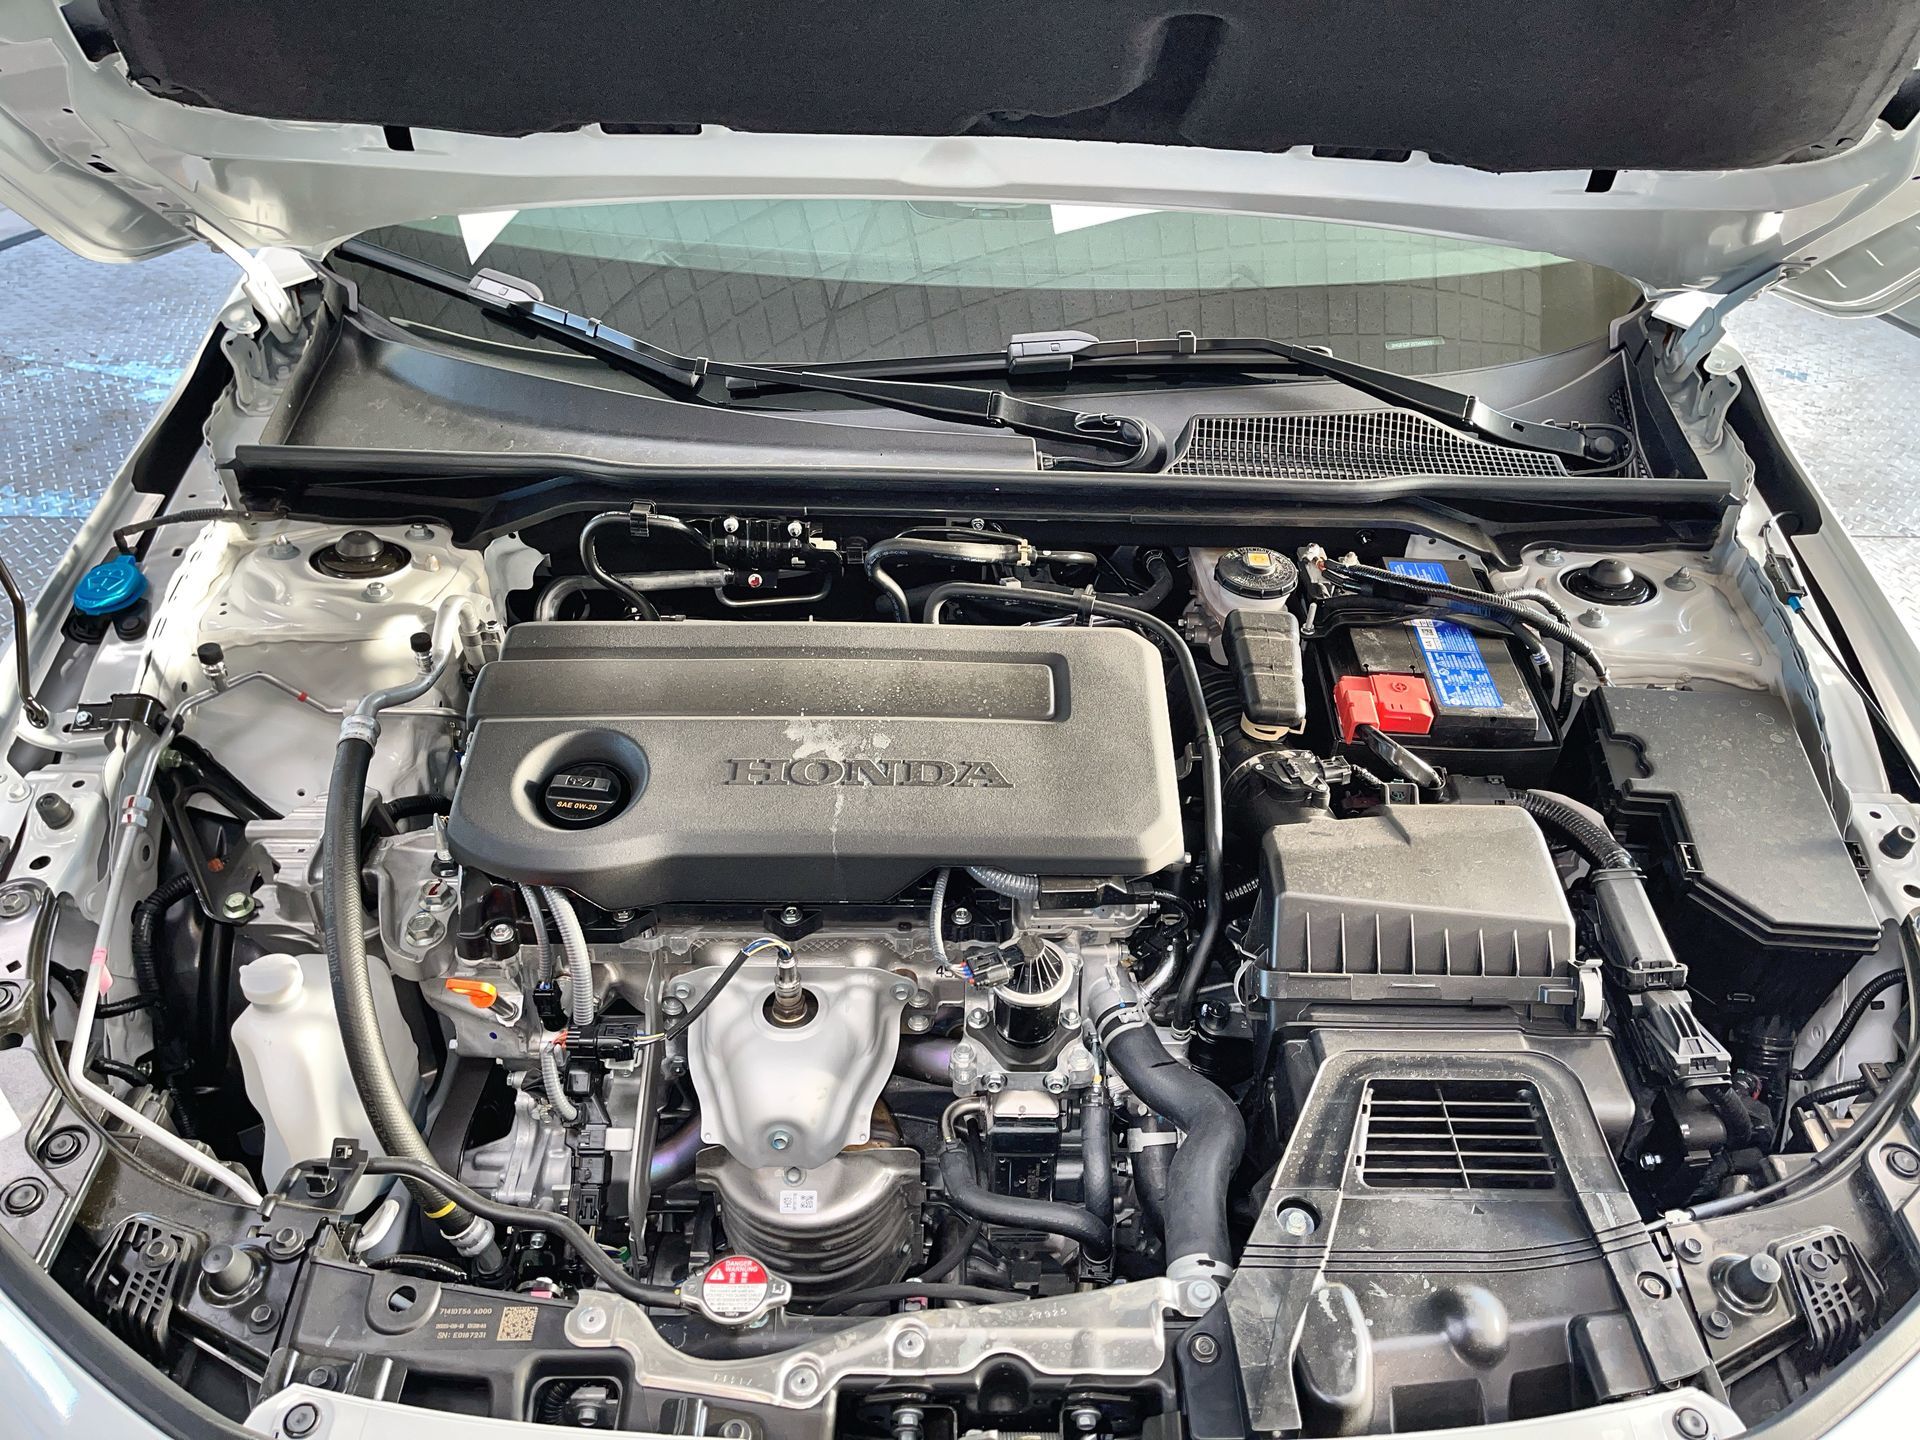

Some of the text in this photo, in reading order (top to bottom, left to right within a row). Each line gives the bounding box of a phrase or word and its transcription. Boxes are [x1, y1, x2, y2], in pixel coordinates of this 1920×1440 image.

[722, 757, 1016, 789] HONDA
[556, 801, 598, 811] SAE 0W-20
[437, 1331, 451, 1339] SN:
